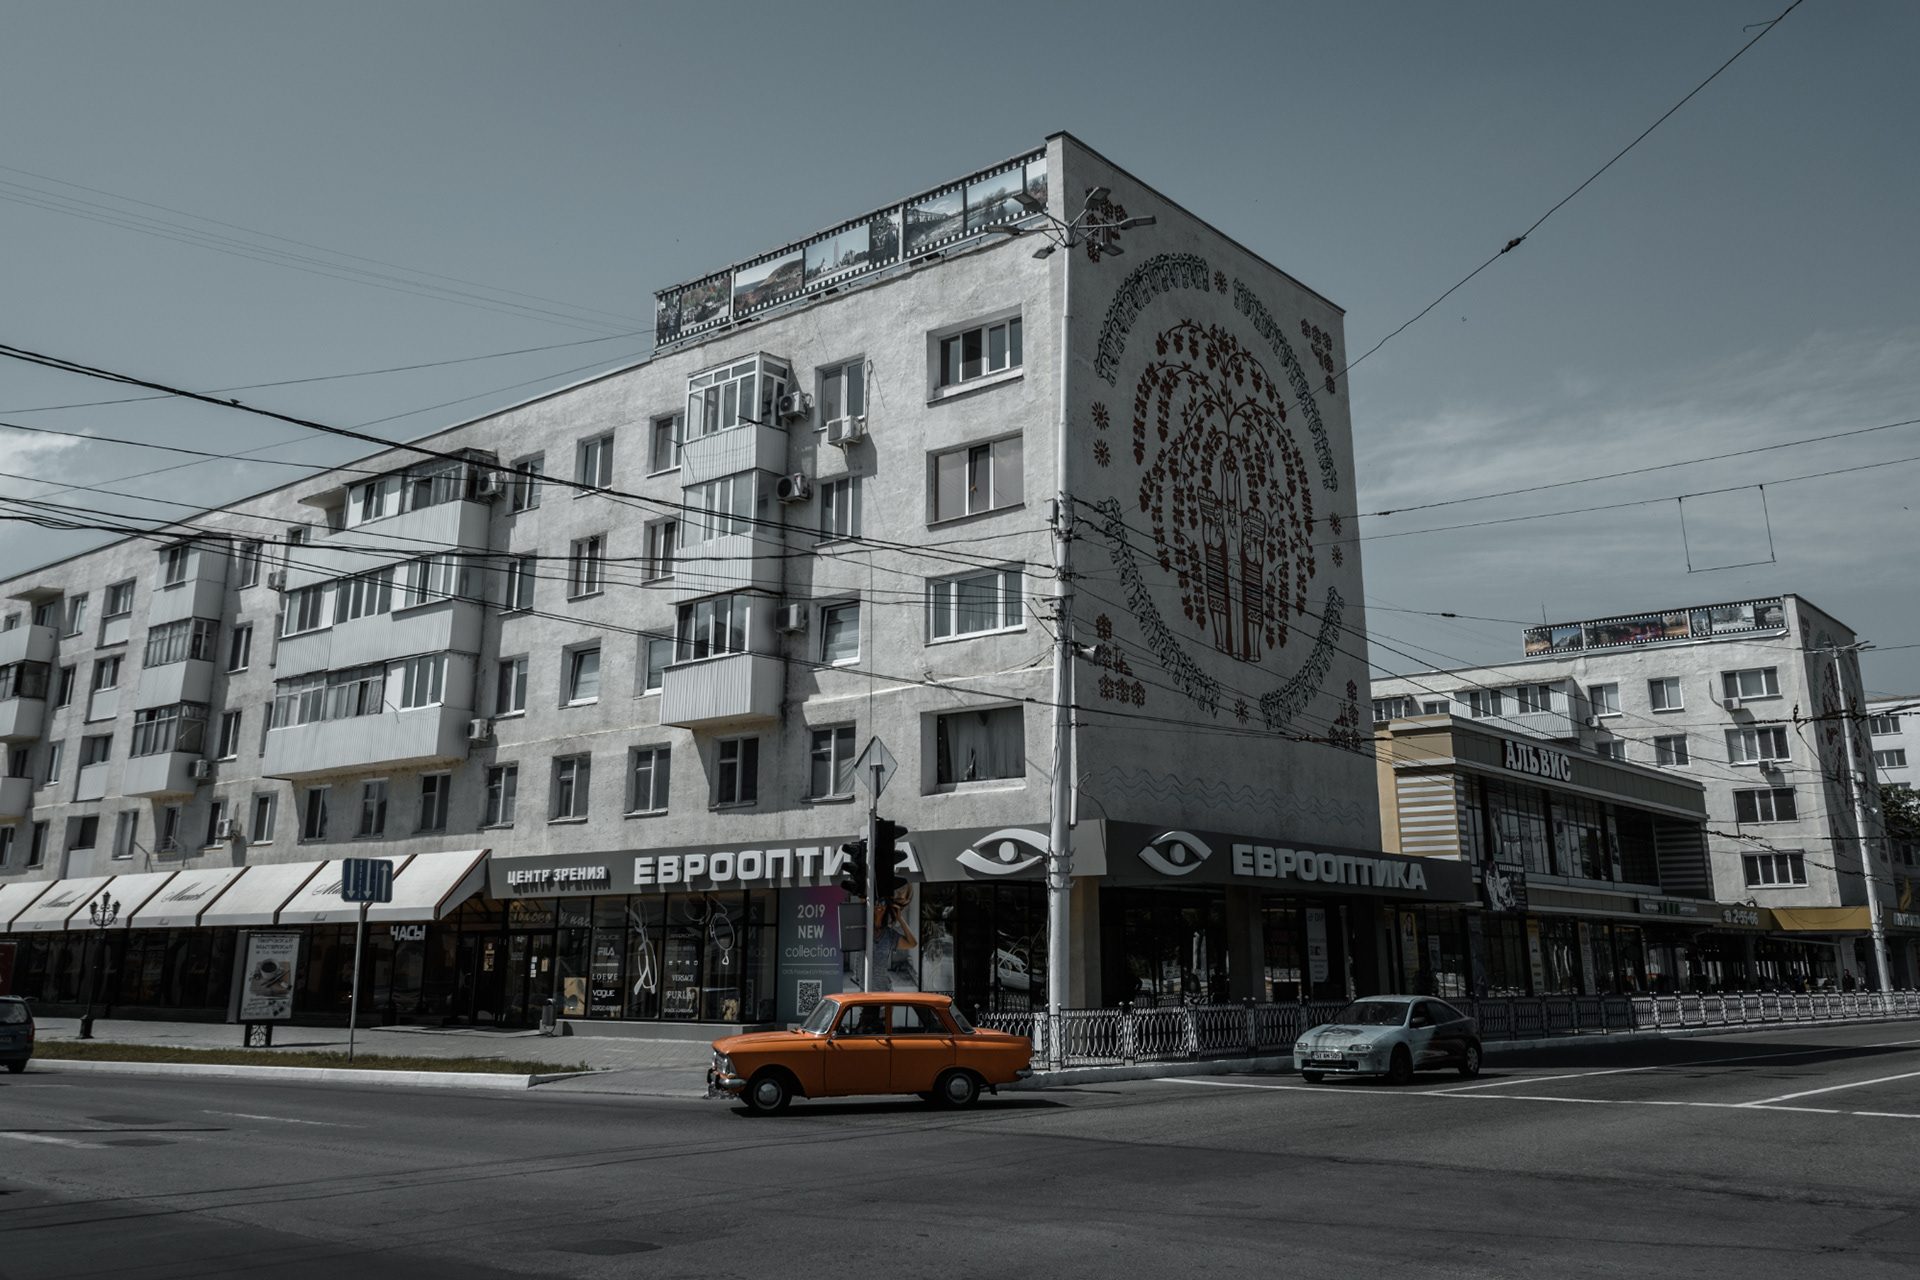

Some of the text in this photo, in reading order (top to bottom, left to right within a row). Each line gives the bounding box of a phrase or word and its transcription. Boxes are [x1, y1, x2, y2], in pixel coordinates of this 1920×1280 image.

[1504, 741, 1572, 783] АЛЬВИС
[633, 841, 920, 885] ЕВРООПТИА
[1231, 843, 1428, 890] ЕВРООПТИКА
[507, 865, 607, 886] ЦЕНТР ЗРЕНИЯ
[797, 904, 825, 919] 2019
[389, 924, 427, 942] ЧАСЫ
[797, 924, 825, 939] NEW
[597, 946, 616, 956] FILA
[785, 944, 837, 958] collection
[592, 972, 619, 981] LOEWE
